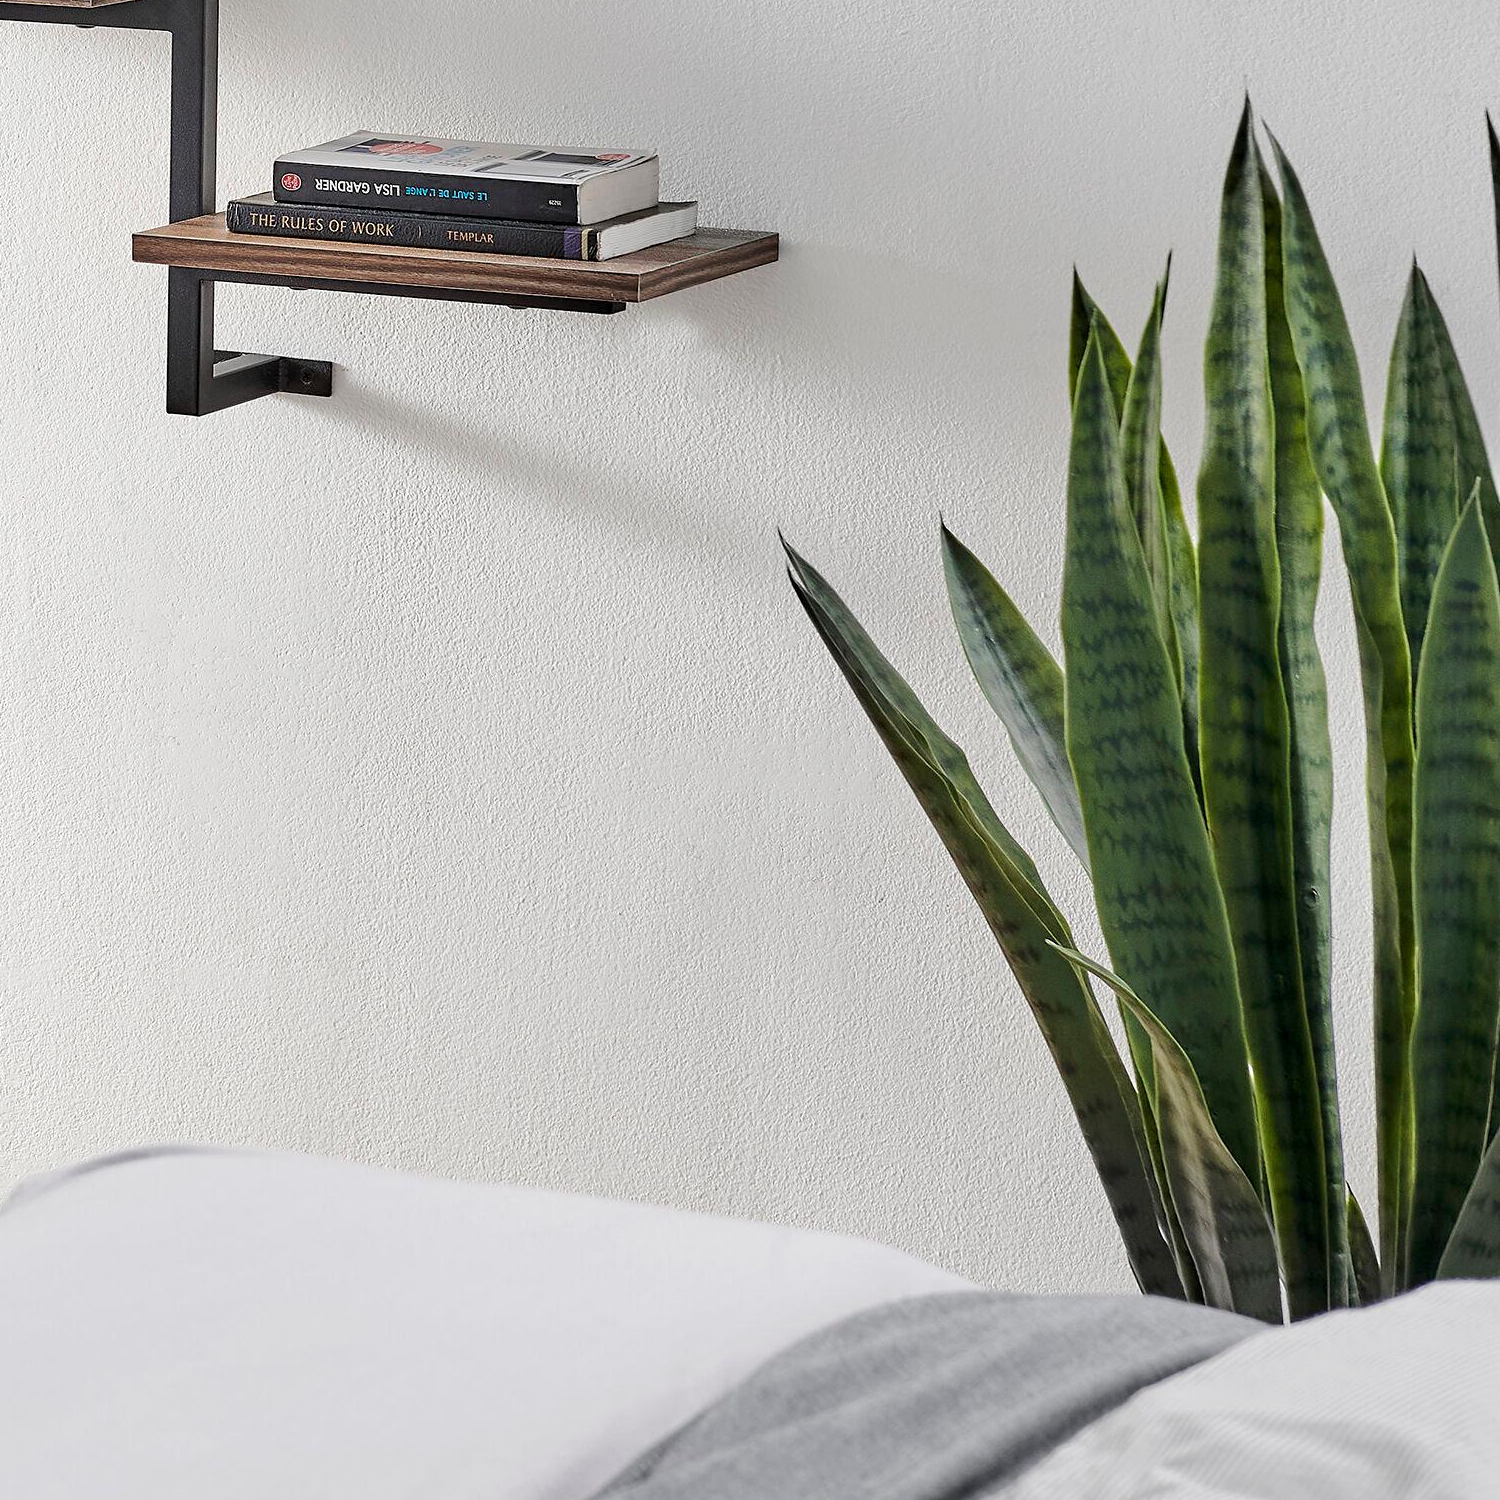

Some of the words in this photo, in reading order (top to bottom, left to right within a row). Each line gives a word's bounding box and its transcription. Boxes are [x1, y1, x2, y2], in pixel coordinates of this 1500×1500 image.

[315, 178, 370, 194] GARDNER
[375, 182, 401, 196] LISA
[405, 186, 436, 197] L'ANGE
[438, 188, 450, 198] DE
[452, 190, 475, 200] SAUT
[477, 191, 488, 201] LE
[250, 213, 277, 227] THE
[281, 215, 324, 231] RULES
[328, 219, 347, 233] OF
[352, 221, 395, 237] WORK
[446, 230, 494, 244] TEMPLAR
